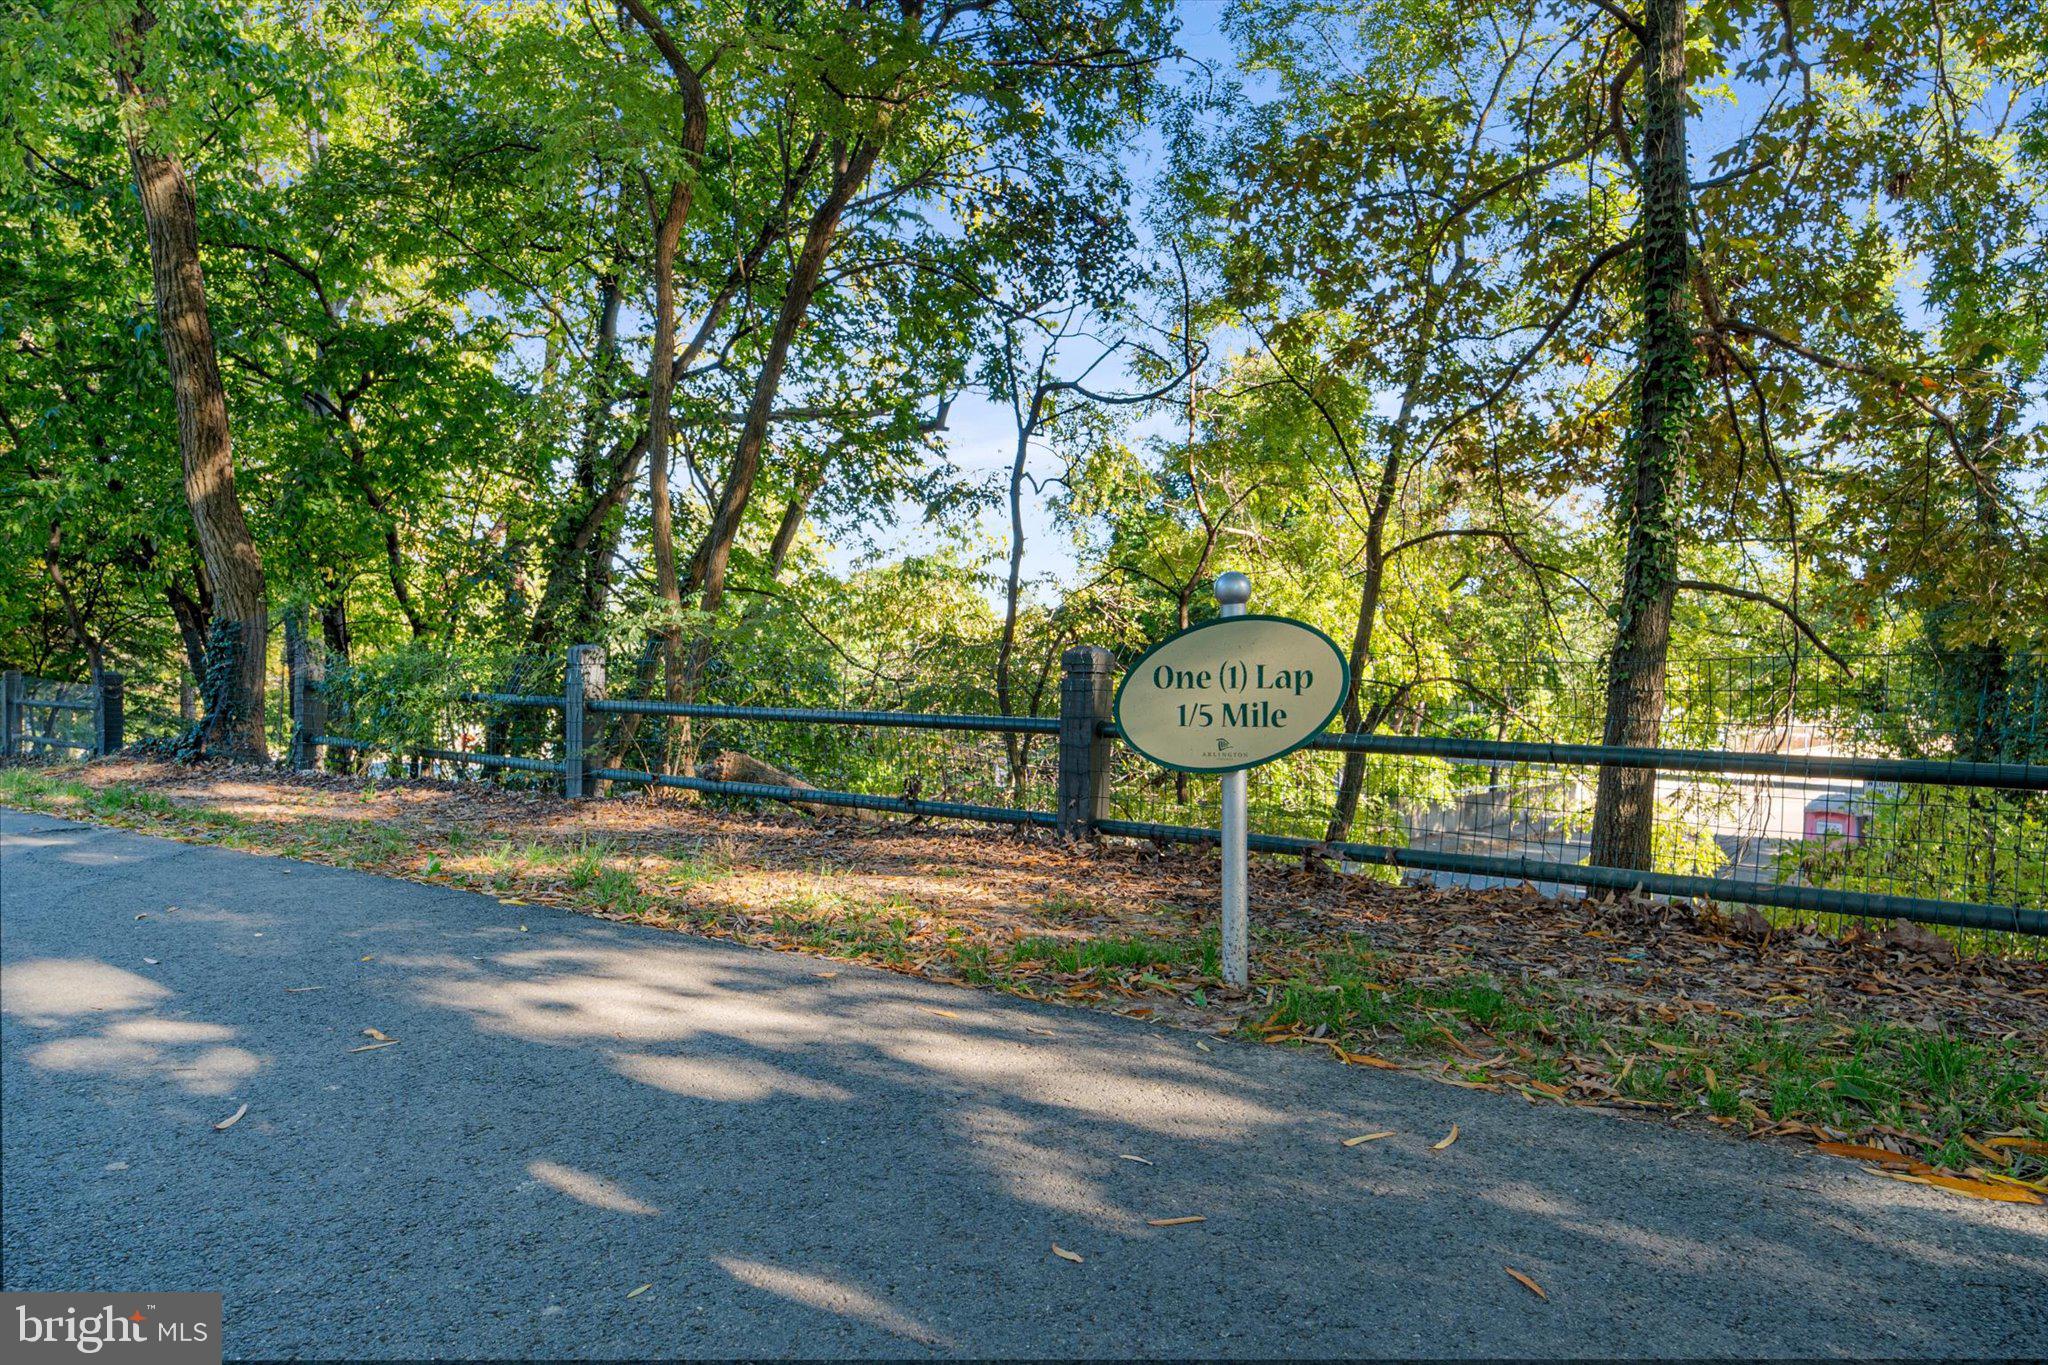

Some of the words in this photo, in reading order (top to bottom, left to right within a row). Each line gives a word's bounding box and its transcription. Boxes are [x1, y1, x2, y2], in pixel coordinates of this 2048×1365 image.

[1153, 664, 1212, 690] One
[1219, 660, 1248, 694] (1)
[1255, 664, 1314, 696] Lap
[1176, 702, 1213, 728] 1/5
[1221, 700, 1288, 728] Mile
